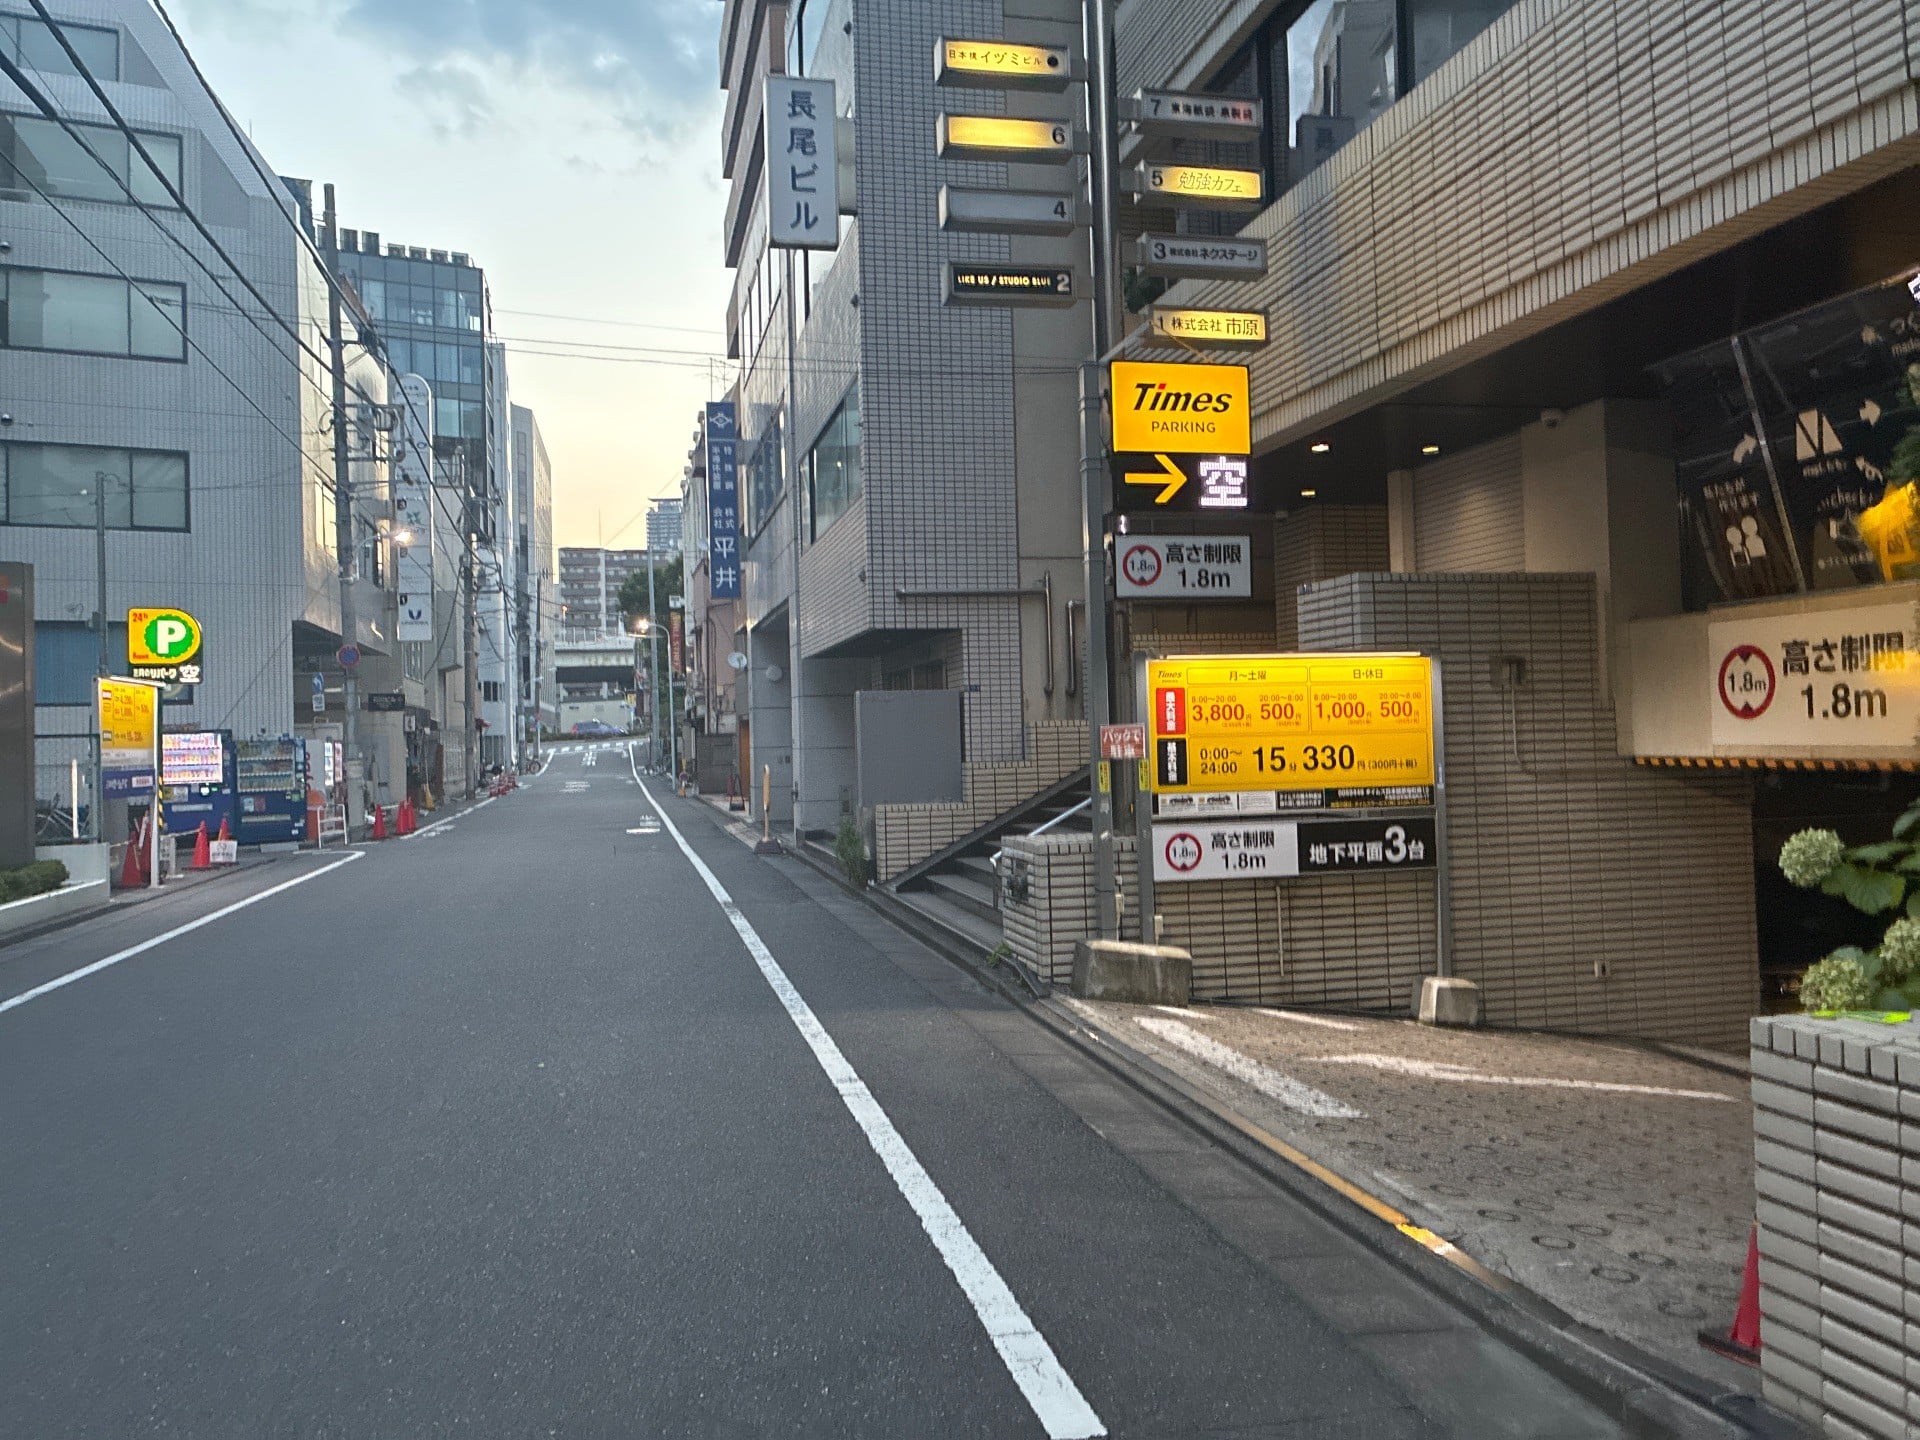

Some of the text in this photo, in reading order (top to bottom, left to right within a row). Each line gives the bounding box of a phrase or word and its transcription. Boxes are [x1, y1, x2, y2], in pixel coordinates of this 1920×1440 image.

[1151, 99, 1161, 116] 7
[1052, 127, 1065, 144] 6
[787, 90, 818, 231] 長尾ビル
[1151, 171, 1242, 192] 5 勉強カフェ
[1053, 201, 1066, 219] 4
[1154, 243, 1166, 260] 3
[958, 275, 975, 284] LIKE
[999, 276, 1029, 286] STUDIO
[1057, 274, 1070, 291] 2
[1157, 316, 1164, 331] 1
[1133, 383, 1232, 413] Times
[1152, 421, 1216, 433] PARKING
[1199, 456, 1248, 507] 空
[1165, 543, 1242, 564] 高さ制限
[714, 537, 737, 590] 平井
[1178, 569, 1231, 588] 1.8m
[157, 620, 186, 654] P
[1781, 631, 1906, 677] 高さ制限
[1728, 671, 1767, 693] 1.8m
[1801, 682, 1887, 720] 1.8m
[1200, 762, 1238, 774] 24:00
[1211, 831, 1275, 850] 高さ制限
[1221, 852, 1266, 870] 1.8m
